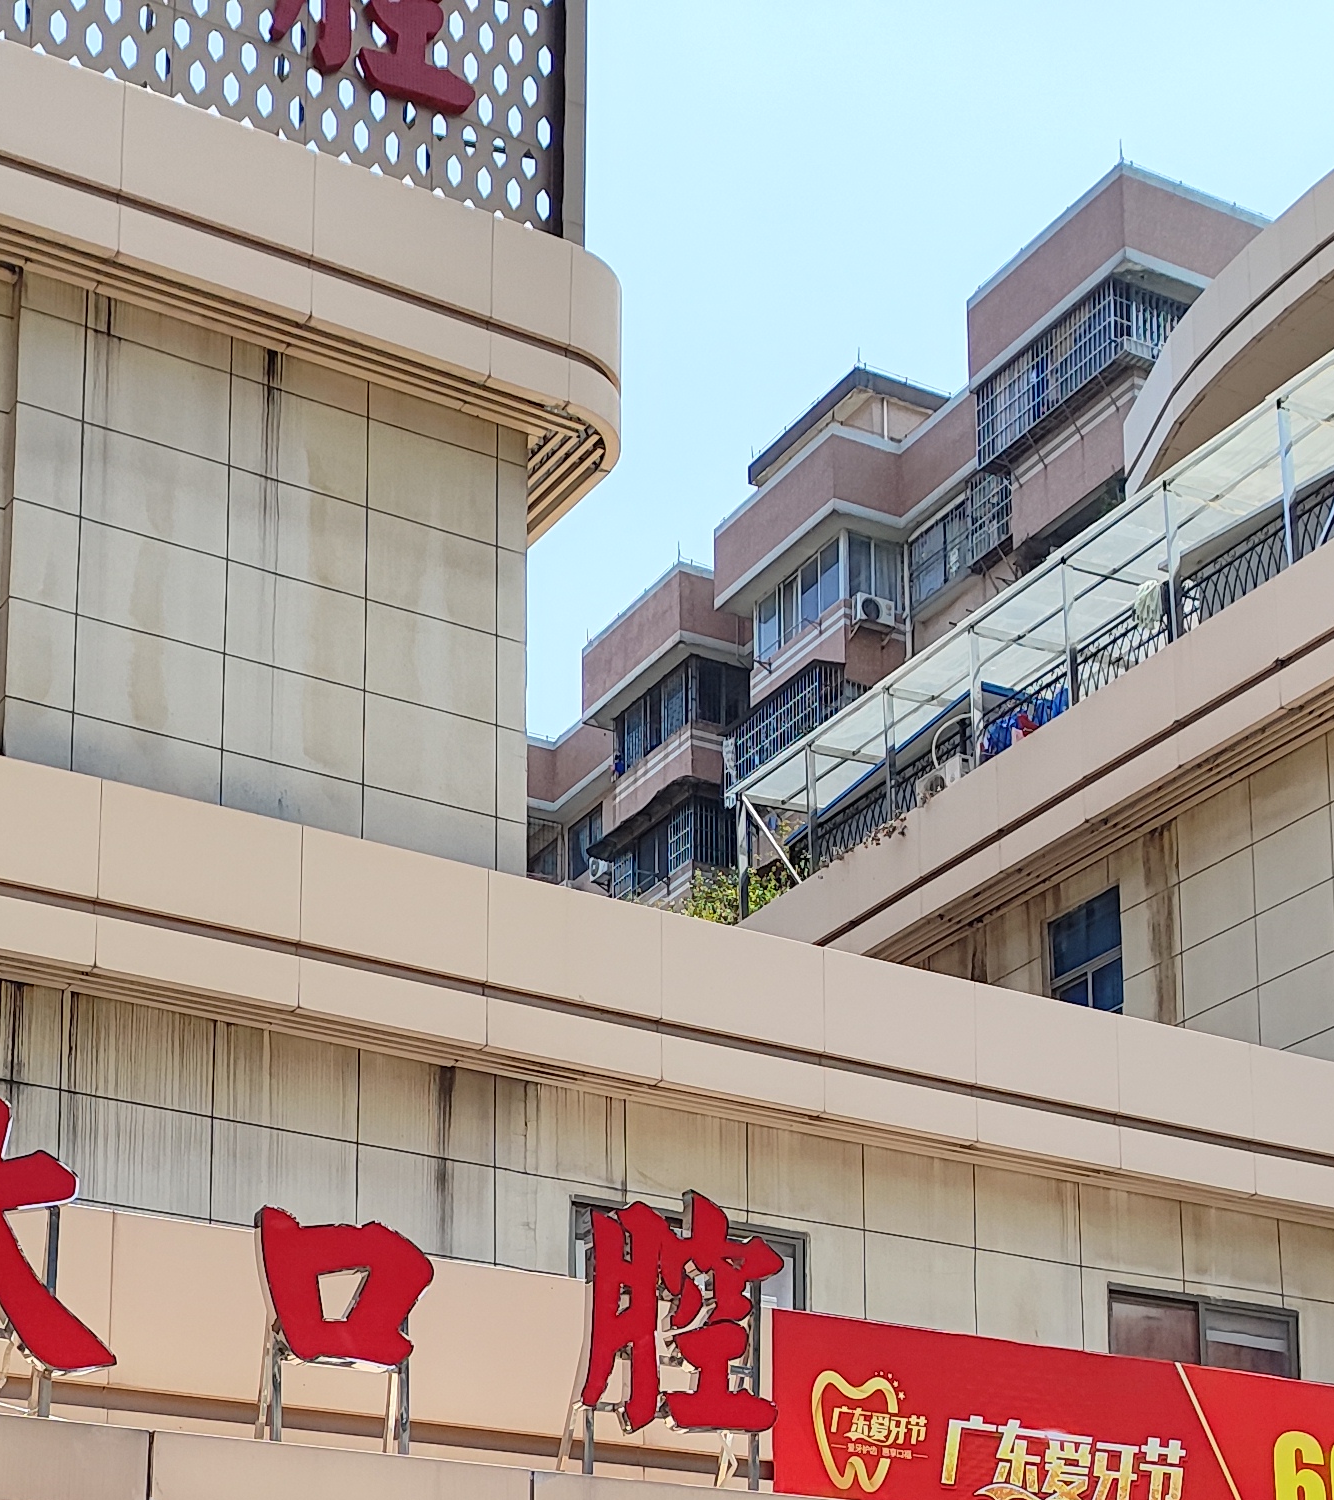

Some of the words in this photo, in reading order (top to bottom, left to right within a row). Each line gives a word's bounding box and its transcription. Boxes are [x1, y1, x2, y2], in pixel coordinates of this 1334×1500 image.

[830, 1405, 928, 1446] 广东爱牙节
